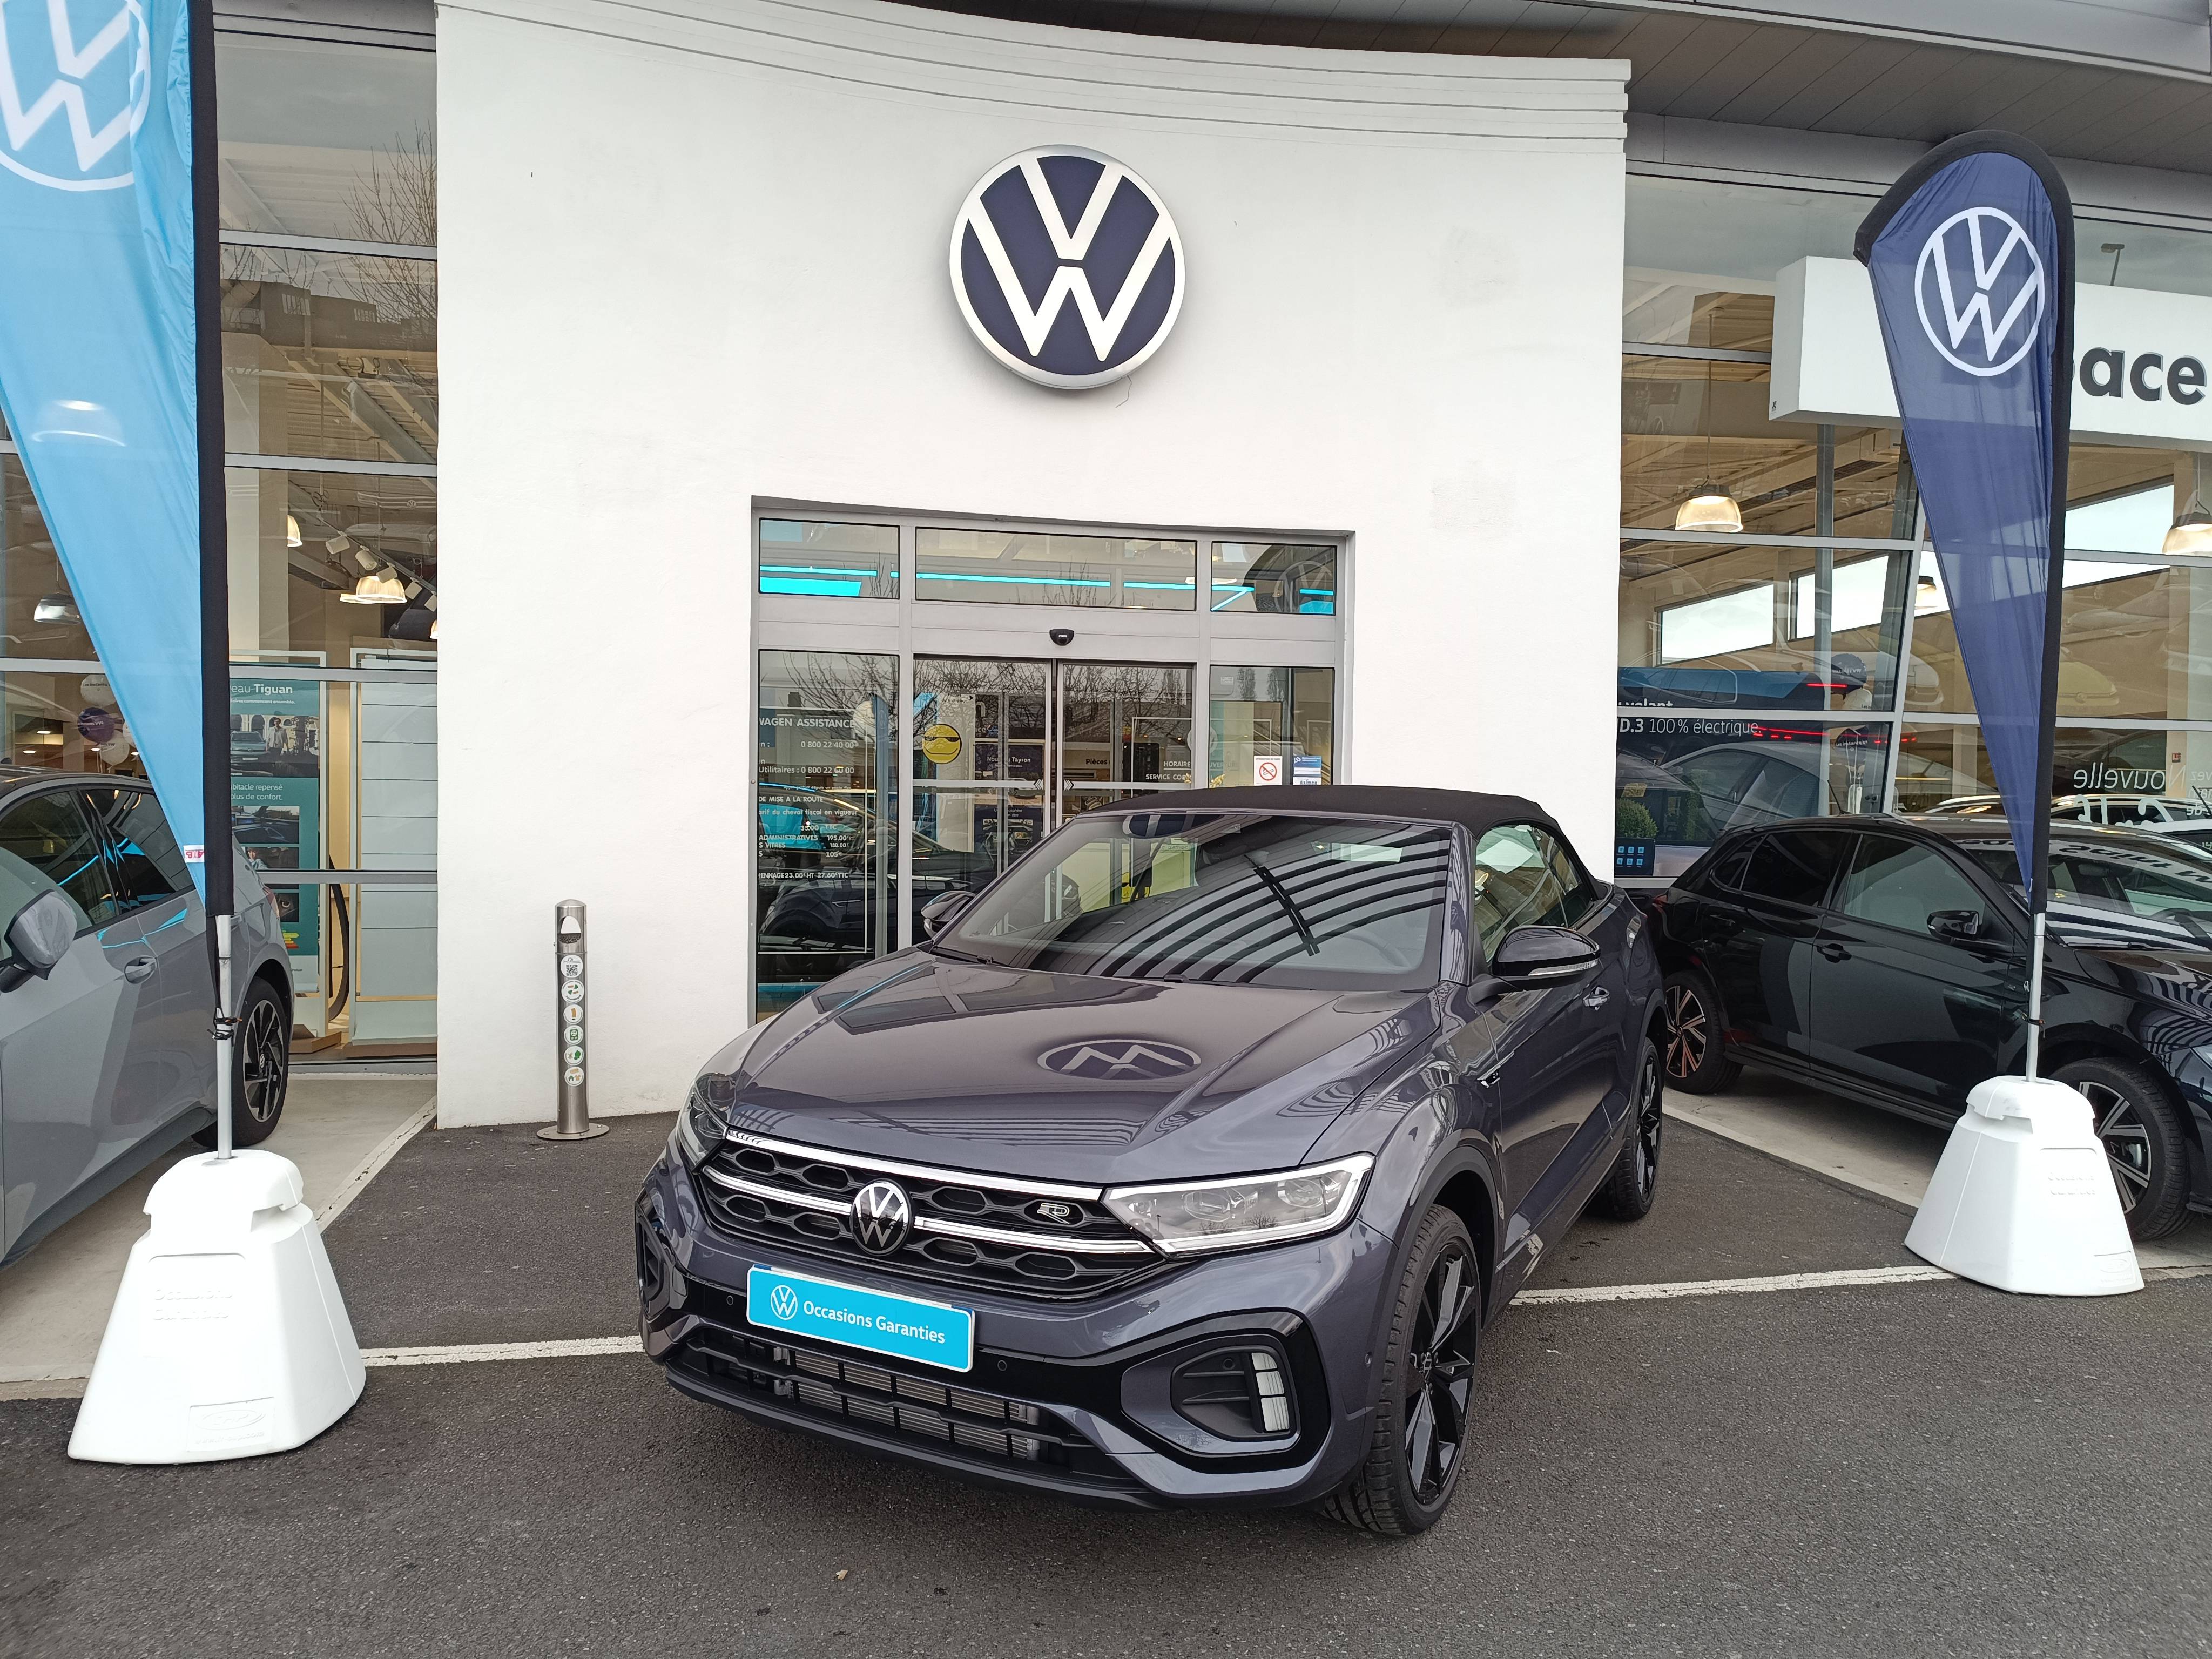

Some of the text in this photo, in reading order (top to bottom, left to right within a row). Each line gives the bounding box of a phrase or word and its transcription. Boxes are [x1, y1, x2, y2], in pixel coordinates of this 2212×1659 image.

[948, 144, 1185, 388] VW
[1915, 206, 2045, 376] VW
[2075, 347, 2207, 406] ace
[253, 684, 293, 696] Tiguan
[797, 719, 854, 728] ASSISTANCE
[1617, 718, 1644, 733] D.3
[1693, 719, 1761, 737] électrique.
[255, 784, 283, 792] repensé
[834, 809, 857, 817] vigueur
[771, 1285, 946, 1344] VW Occasions Garanties
